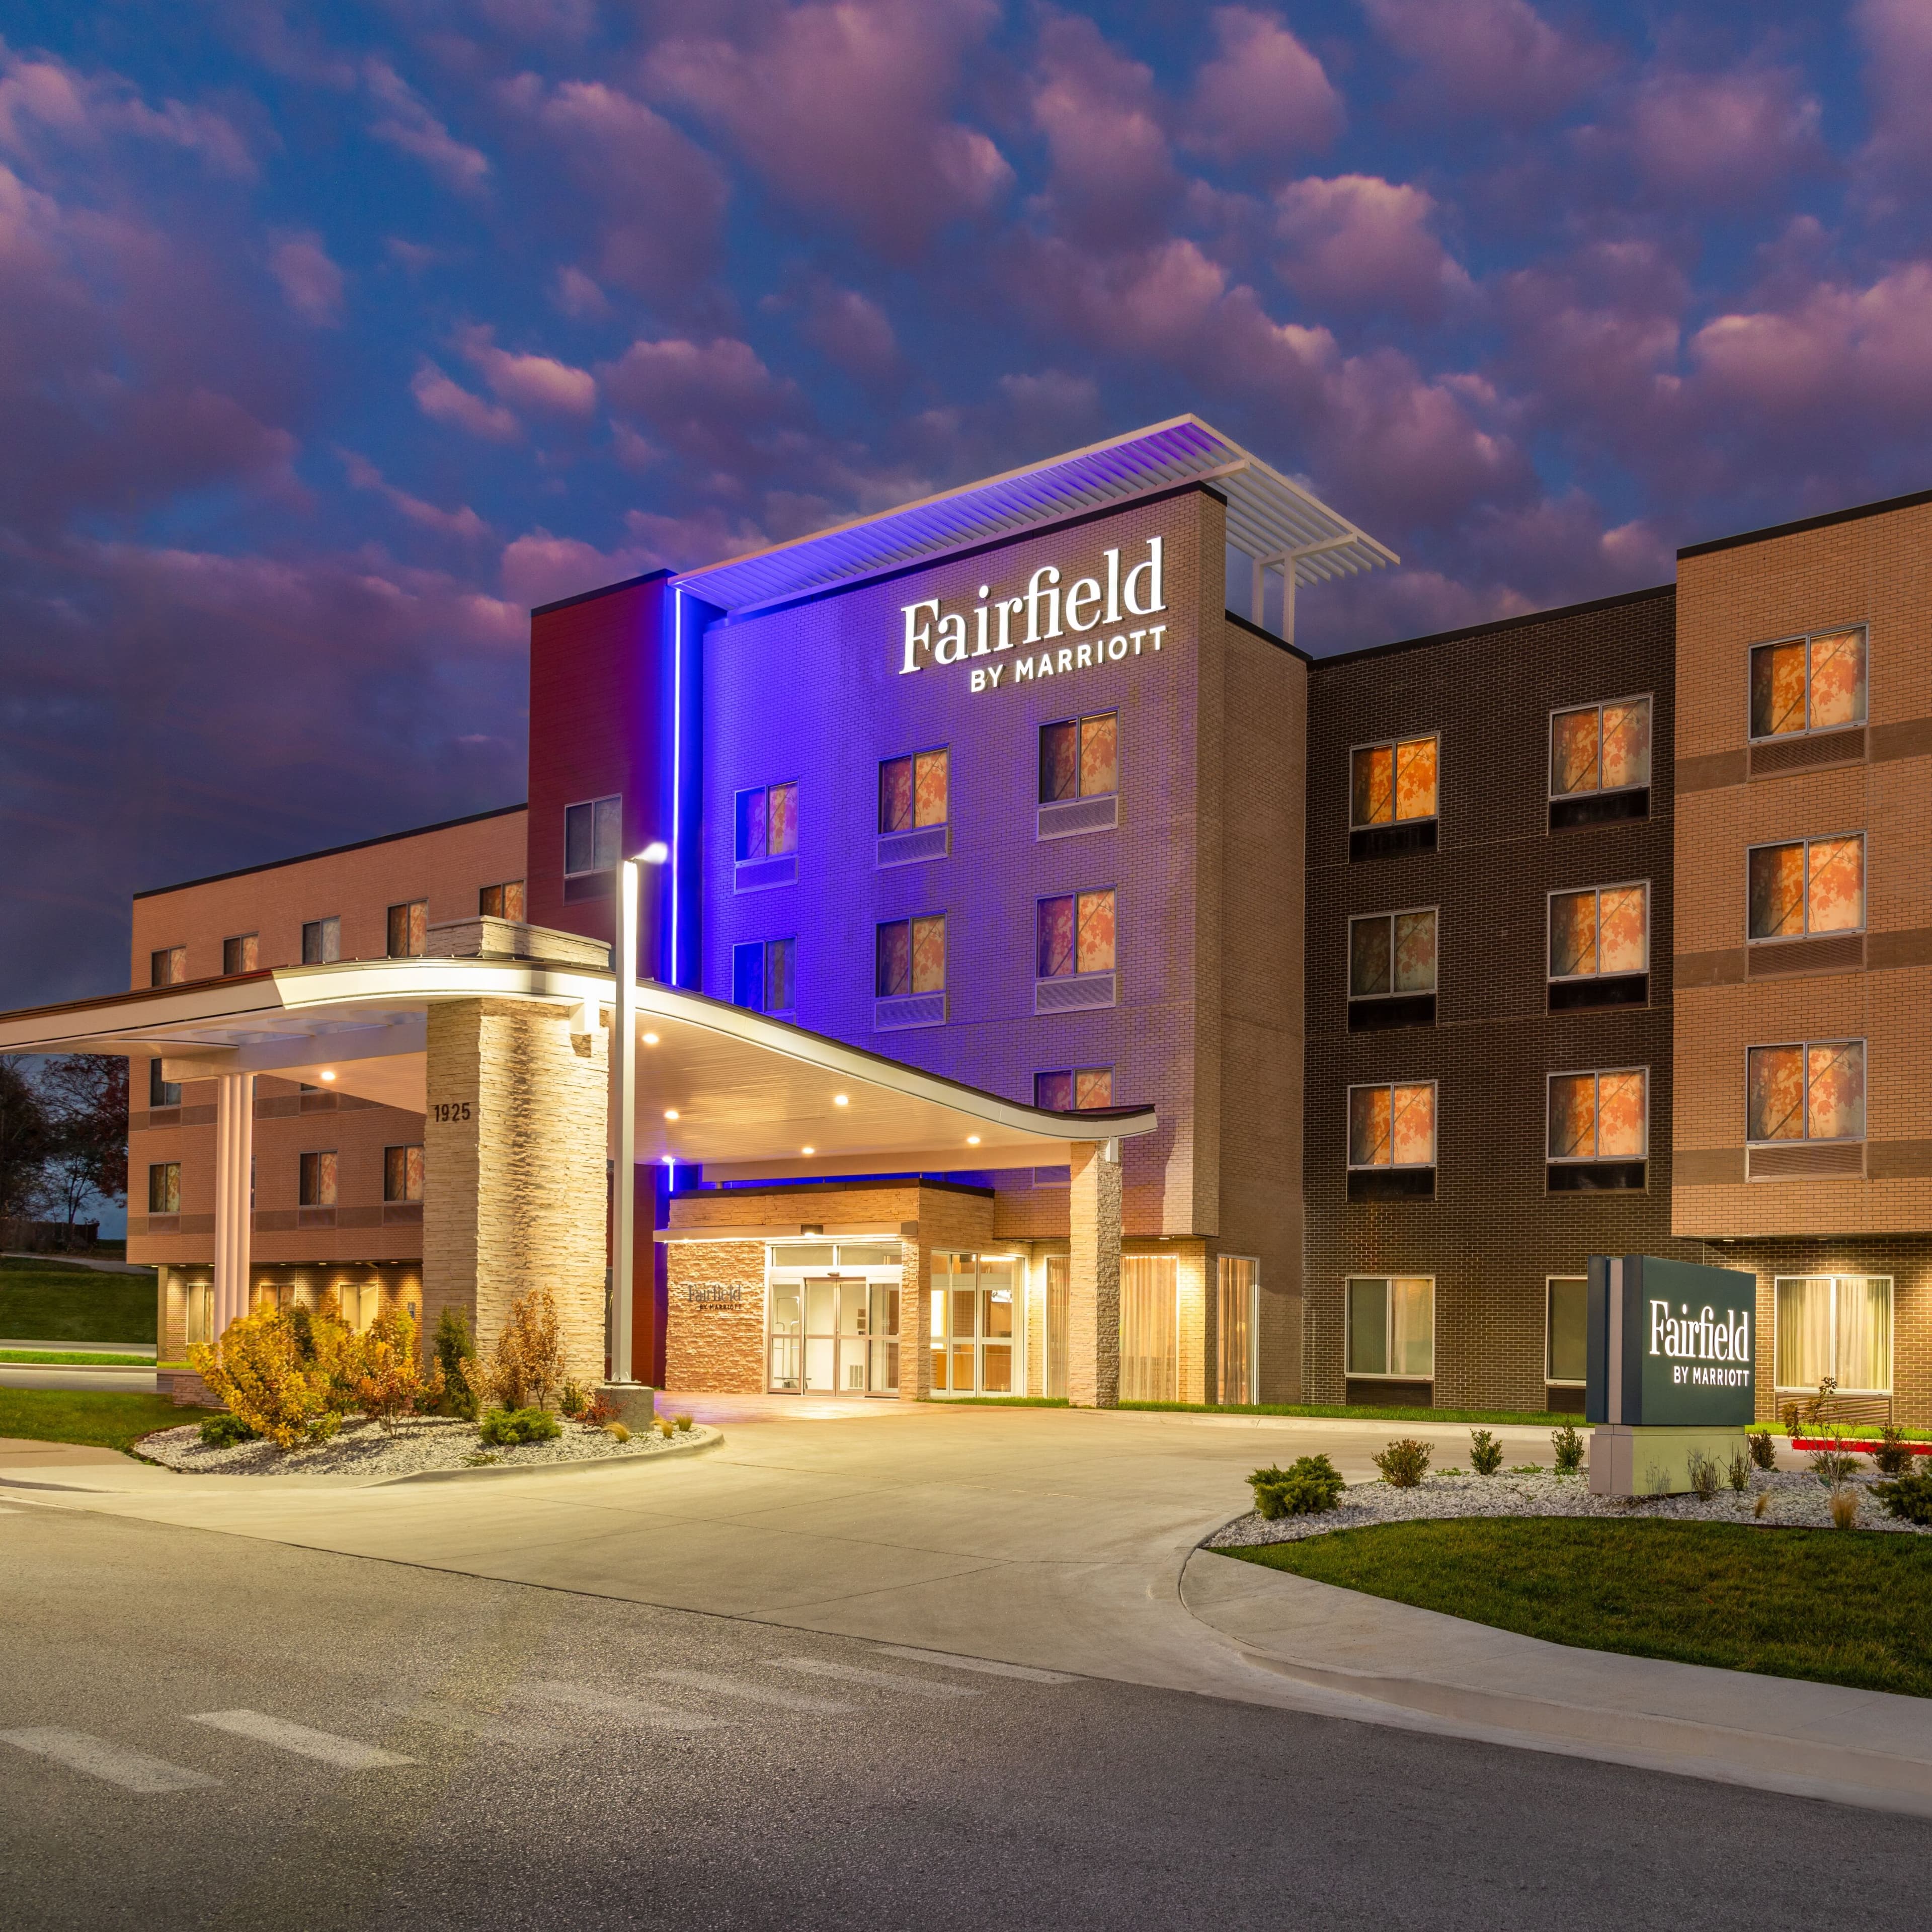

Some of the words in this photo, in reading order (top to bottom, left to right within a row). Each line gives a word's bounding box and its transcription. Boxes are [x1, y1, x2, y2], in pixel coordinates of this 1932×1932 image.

[899, 536, 1167, 674] Fairfield
[971, 665, 1005, 693] BY
[1015, 625, 1167, 683] MARRIOTT
[434, 1102, 470, 1122] 1925
[688, 1283, 741, 1302] Fairfield
[1649, 1300, 1749, 1361] Fairfield
[1673, 1365, 1688, 1384] BY
[1693, 1367, 1750, 1387] MARRIOTT
